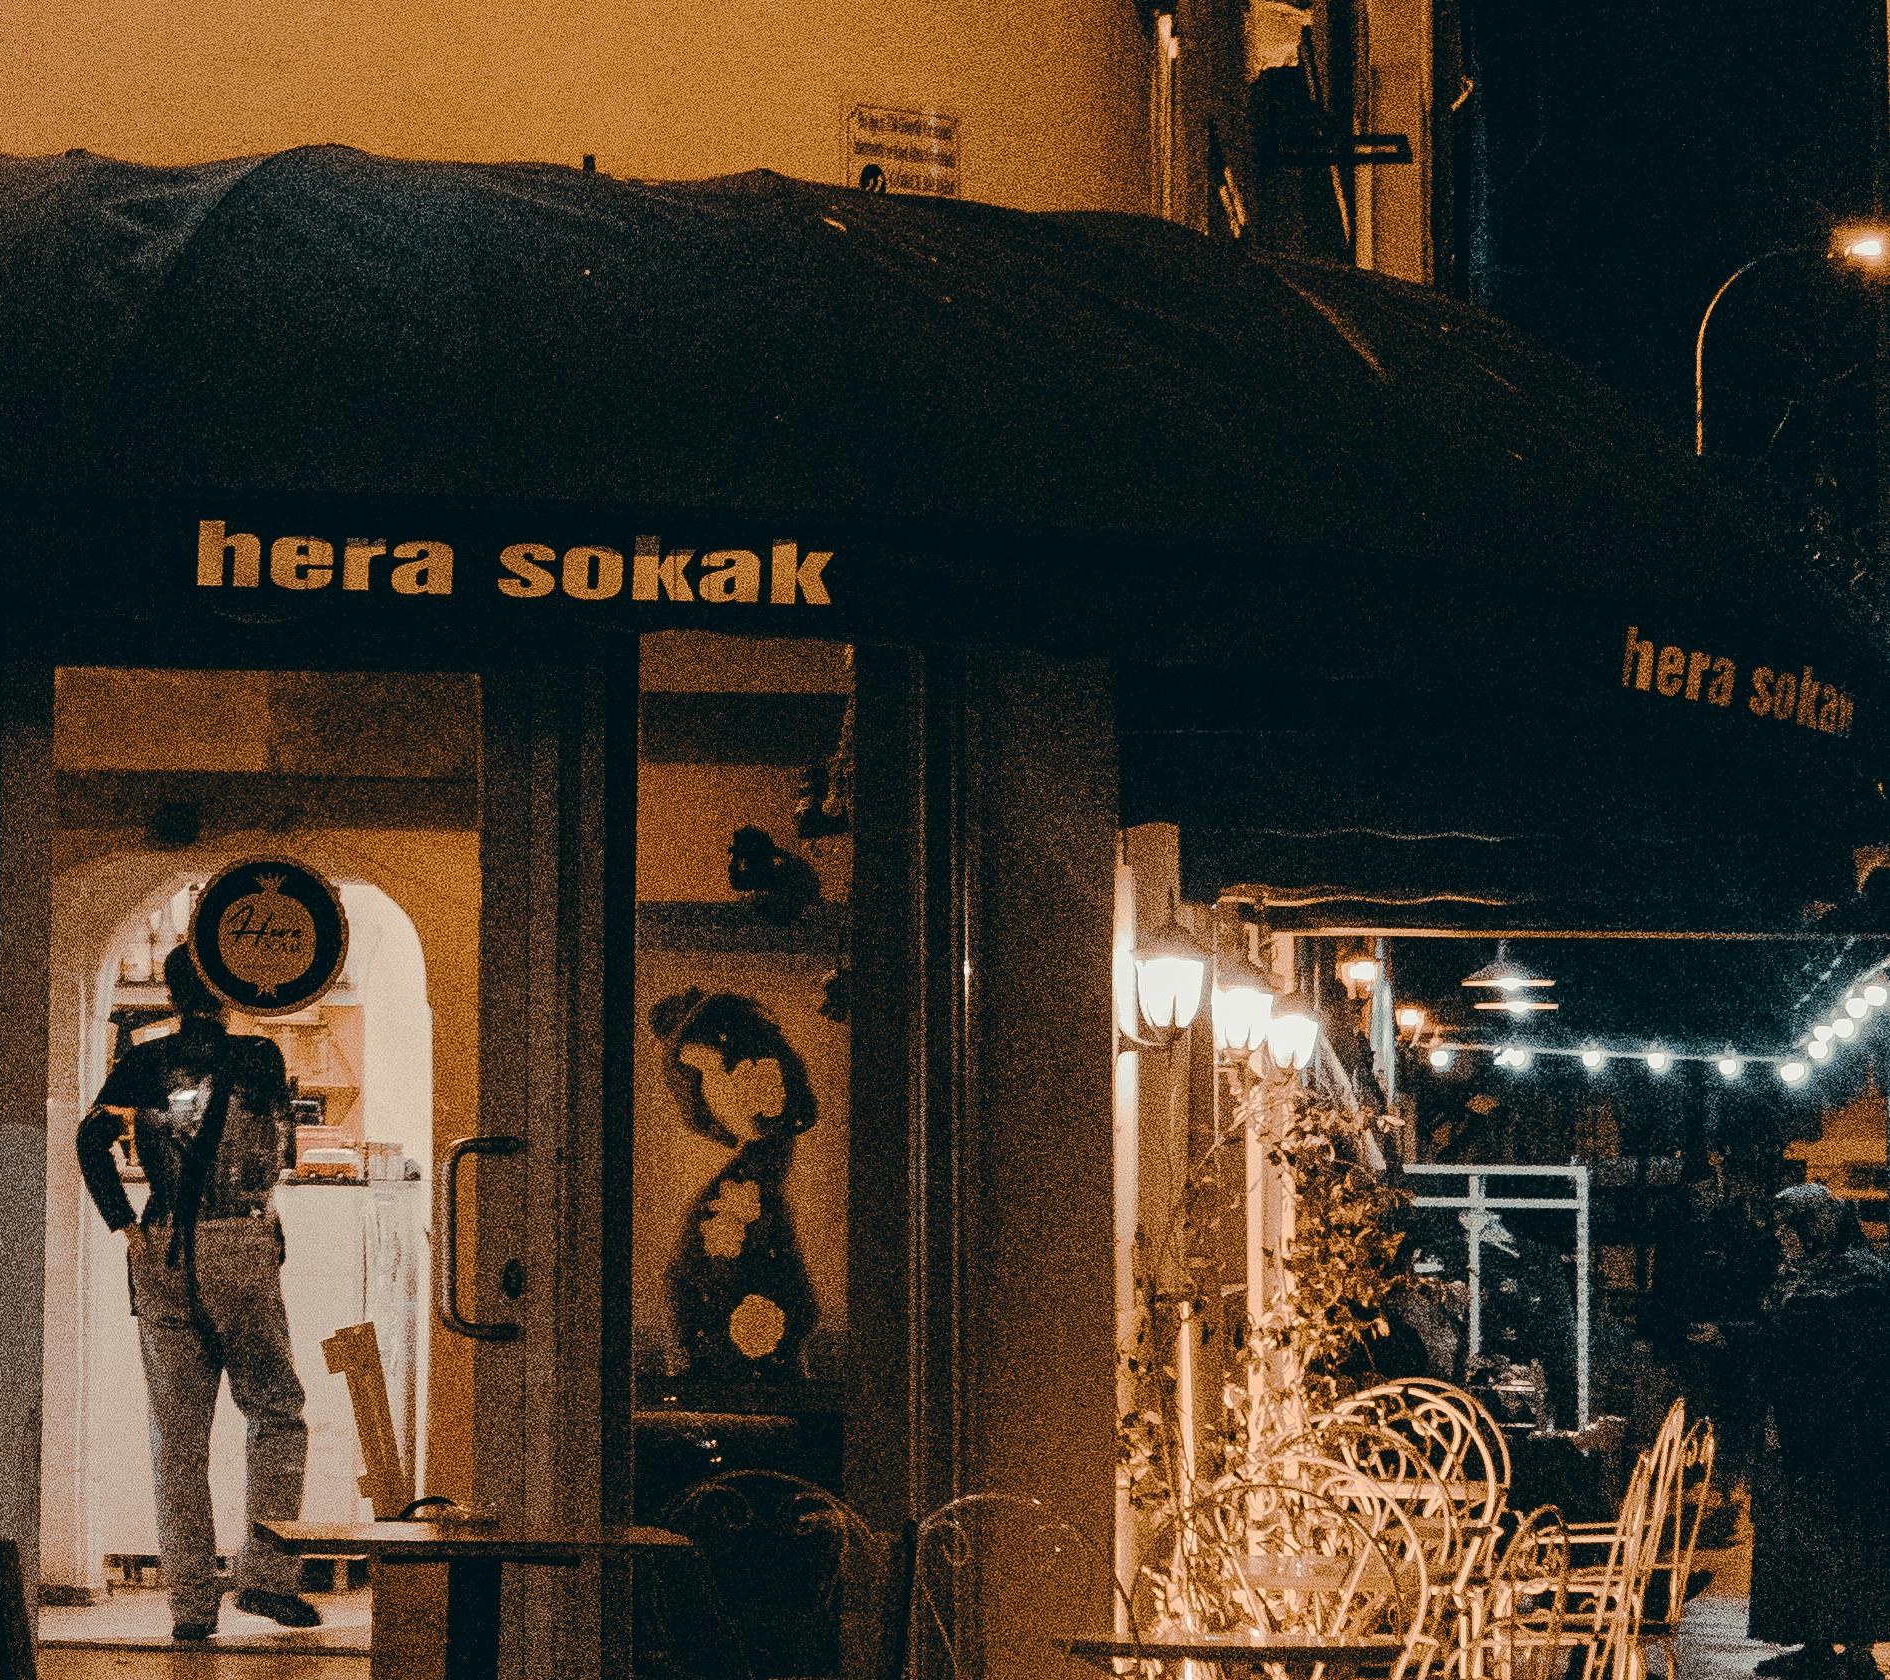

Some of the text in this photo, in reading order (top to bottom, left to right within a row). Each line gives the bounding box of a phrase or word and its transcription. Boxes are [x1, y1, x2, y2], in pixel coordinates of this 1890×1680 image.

[196, 519, 834, 606] hera sokak
[1622, 625, 1737, 708] hera
